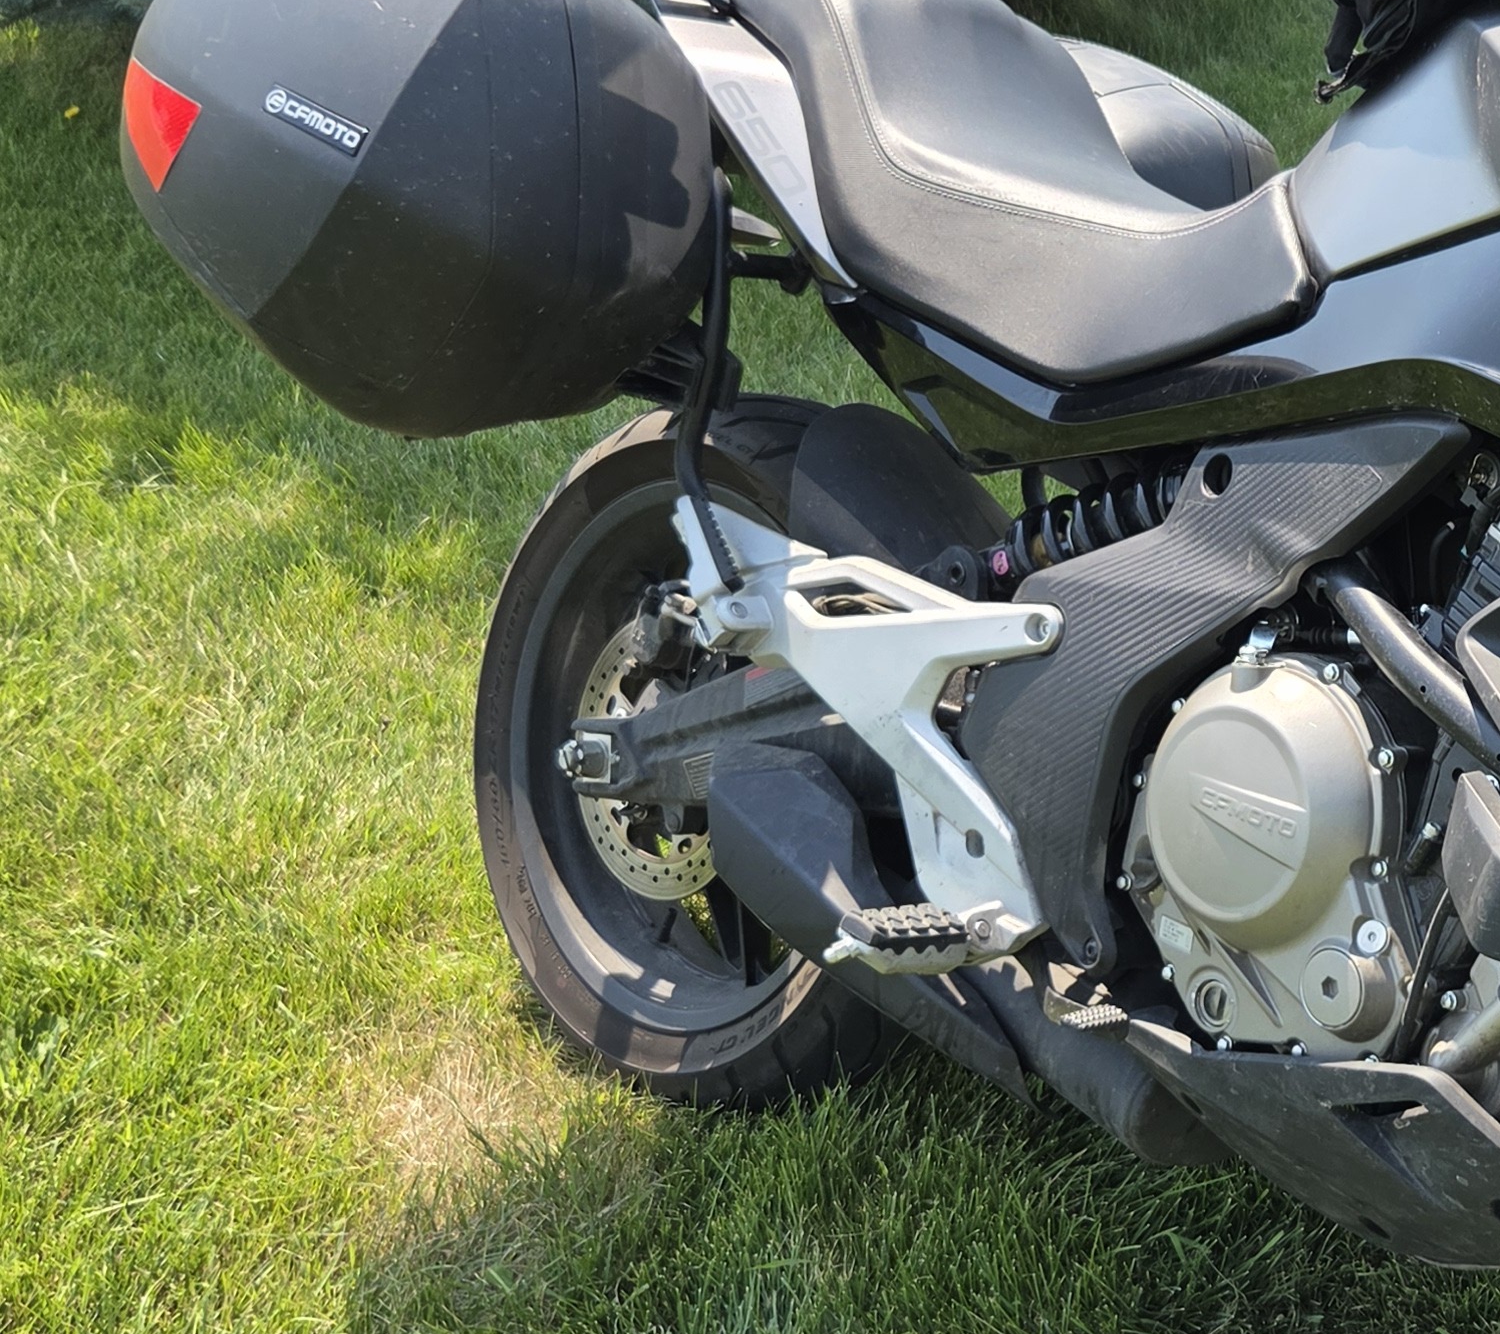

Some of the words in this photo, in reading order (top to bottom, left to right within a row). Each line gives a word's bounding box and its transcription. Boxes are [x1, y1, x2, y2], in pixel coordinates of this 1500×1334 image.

[284, 99, 361, 148] CFMOTO
[713, 80, 807, 197] 650
[1201, 787, 1297, 839] CFMOTO
